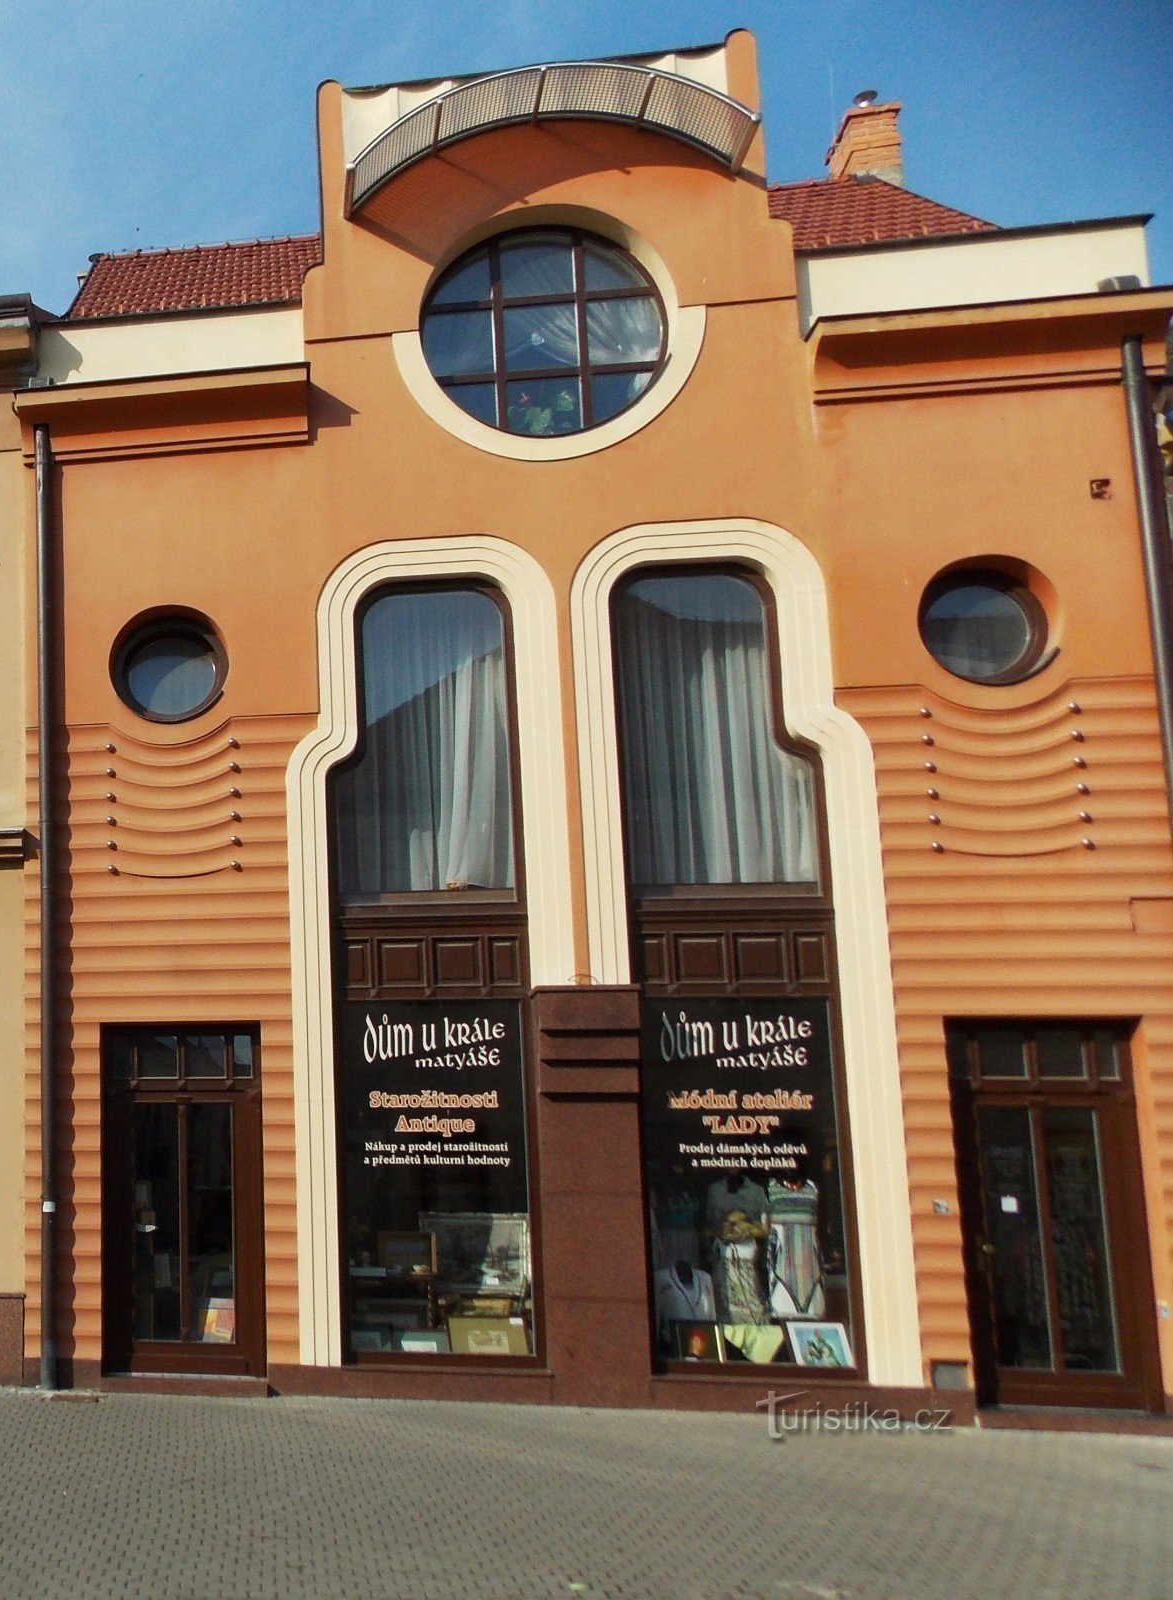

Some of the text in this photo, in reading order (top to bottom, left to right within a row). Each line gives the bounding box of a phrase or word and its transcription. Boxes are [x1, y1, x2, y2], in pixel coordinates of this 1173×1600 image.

[422, 1023, 437, 1051] u
[723, 1020, 739, 1051] u
[415, 1045, 501, 1071] matyáše
[716, 1044, 809, 1070] matyáše
[369, 1090, 499, 1108] Starožitnosti
[667, 1088, 814, 1109] Módní ateliér
[394, 1115, 476, 1137] Antique
[365, 1142, 398, 1153] Nákup
[408, 1142, 441, 1154] prodej
[679, 1143, 807, 1156] Prodej dámských oděvů
[372, 1155, 421, 1167] předmětů
[423, 1154, 465, 1165] kulturní
[467, 1154, 511, 1167] hodnoty
[691, 1160, 698, 1168] a
[701, 1157, 748, 1168] módních
